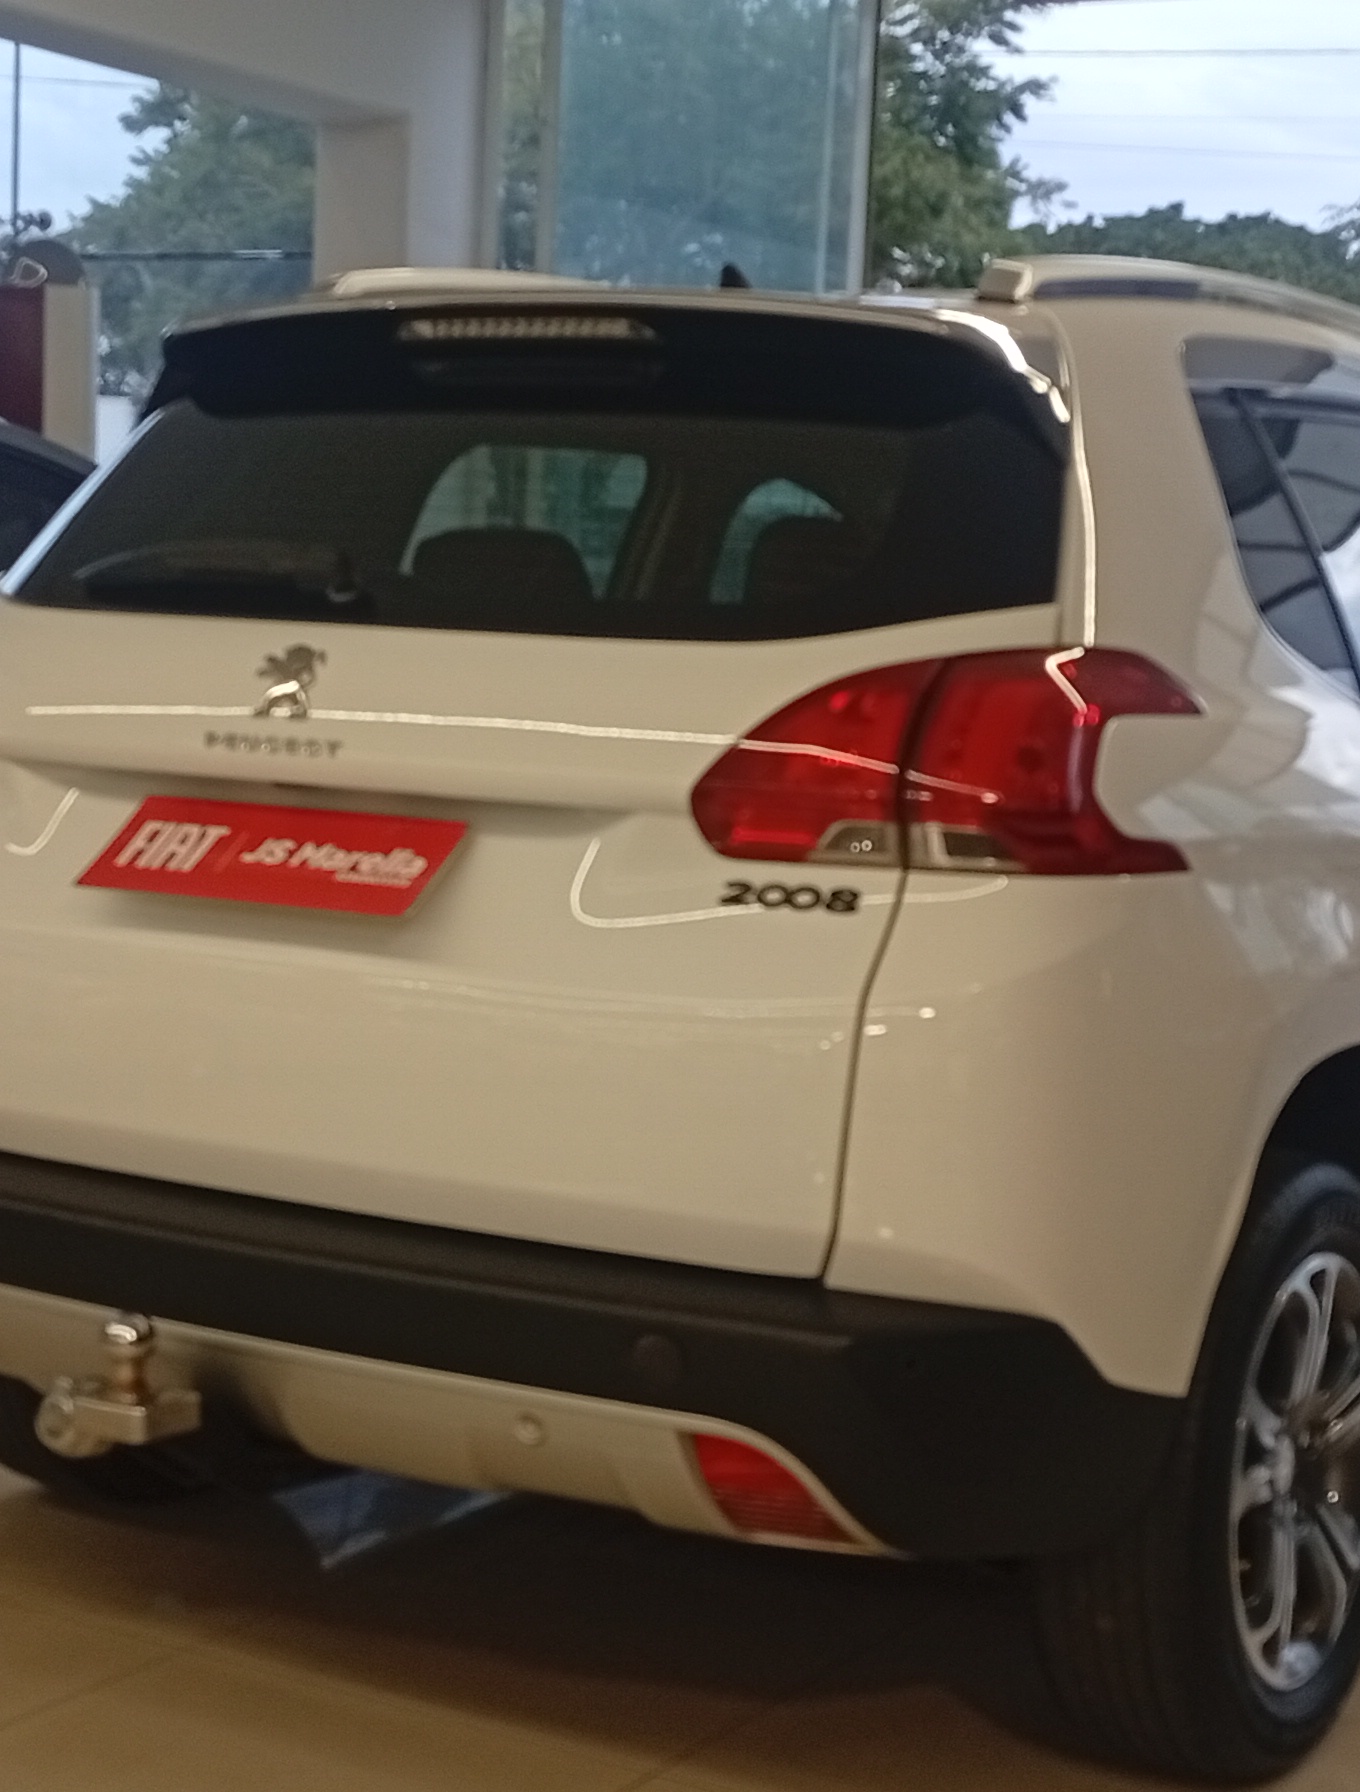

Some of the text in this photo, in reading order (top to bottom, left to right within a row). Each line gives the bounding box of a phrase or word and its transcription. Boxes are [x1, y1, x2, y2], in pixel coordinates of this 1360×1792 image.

[204, 730, 343, 758] PEUGEOT
[113, 819, 232, 873] FIAT
[240, 836, 298, 866] JS
[288, 840, 429, 879] Marella
[719, 880, 860, 914] 2008
